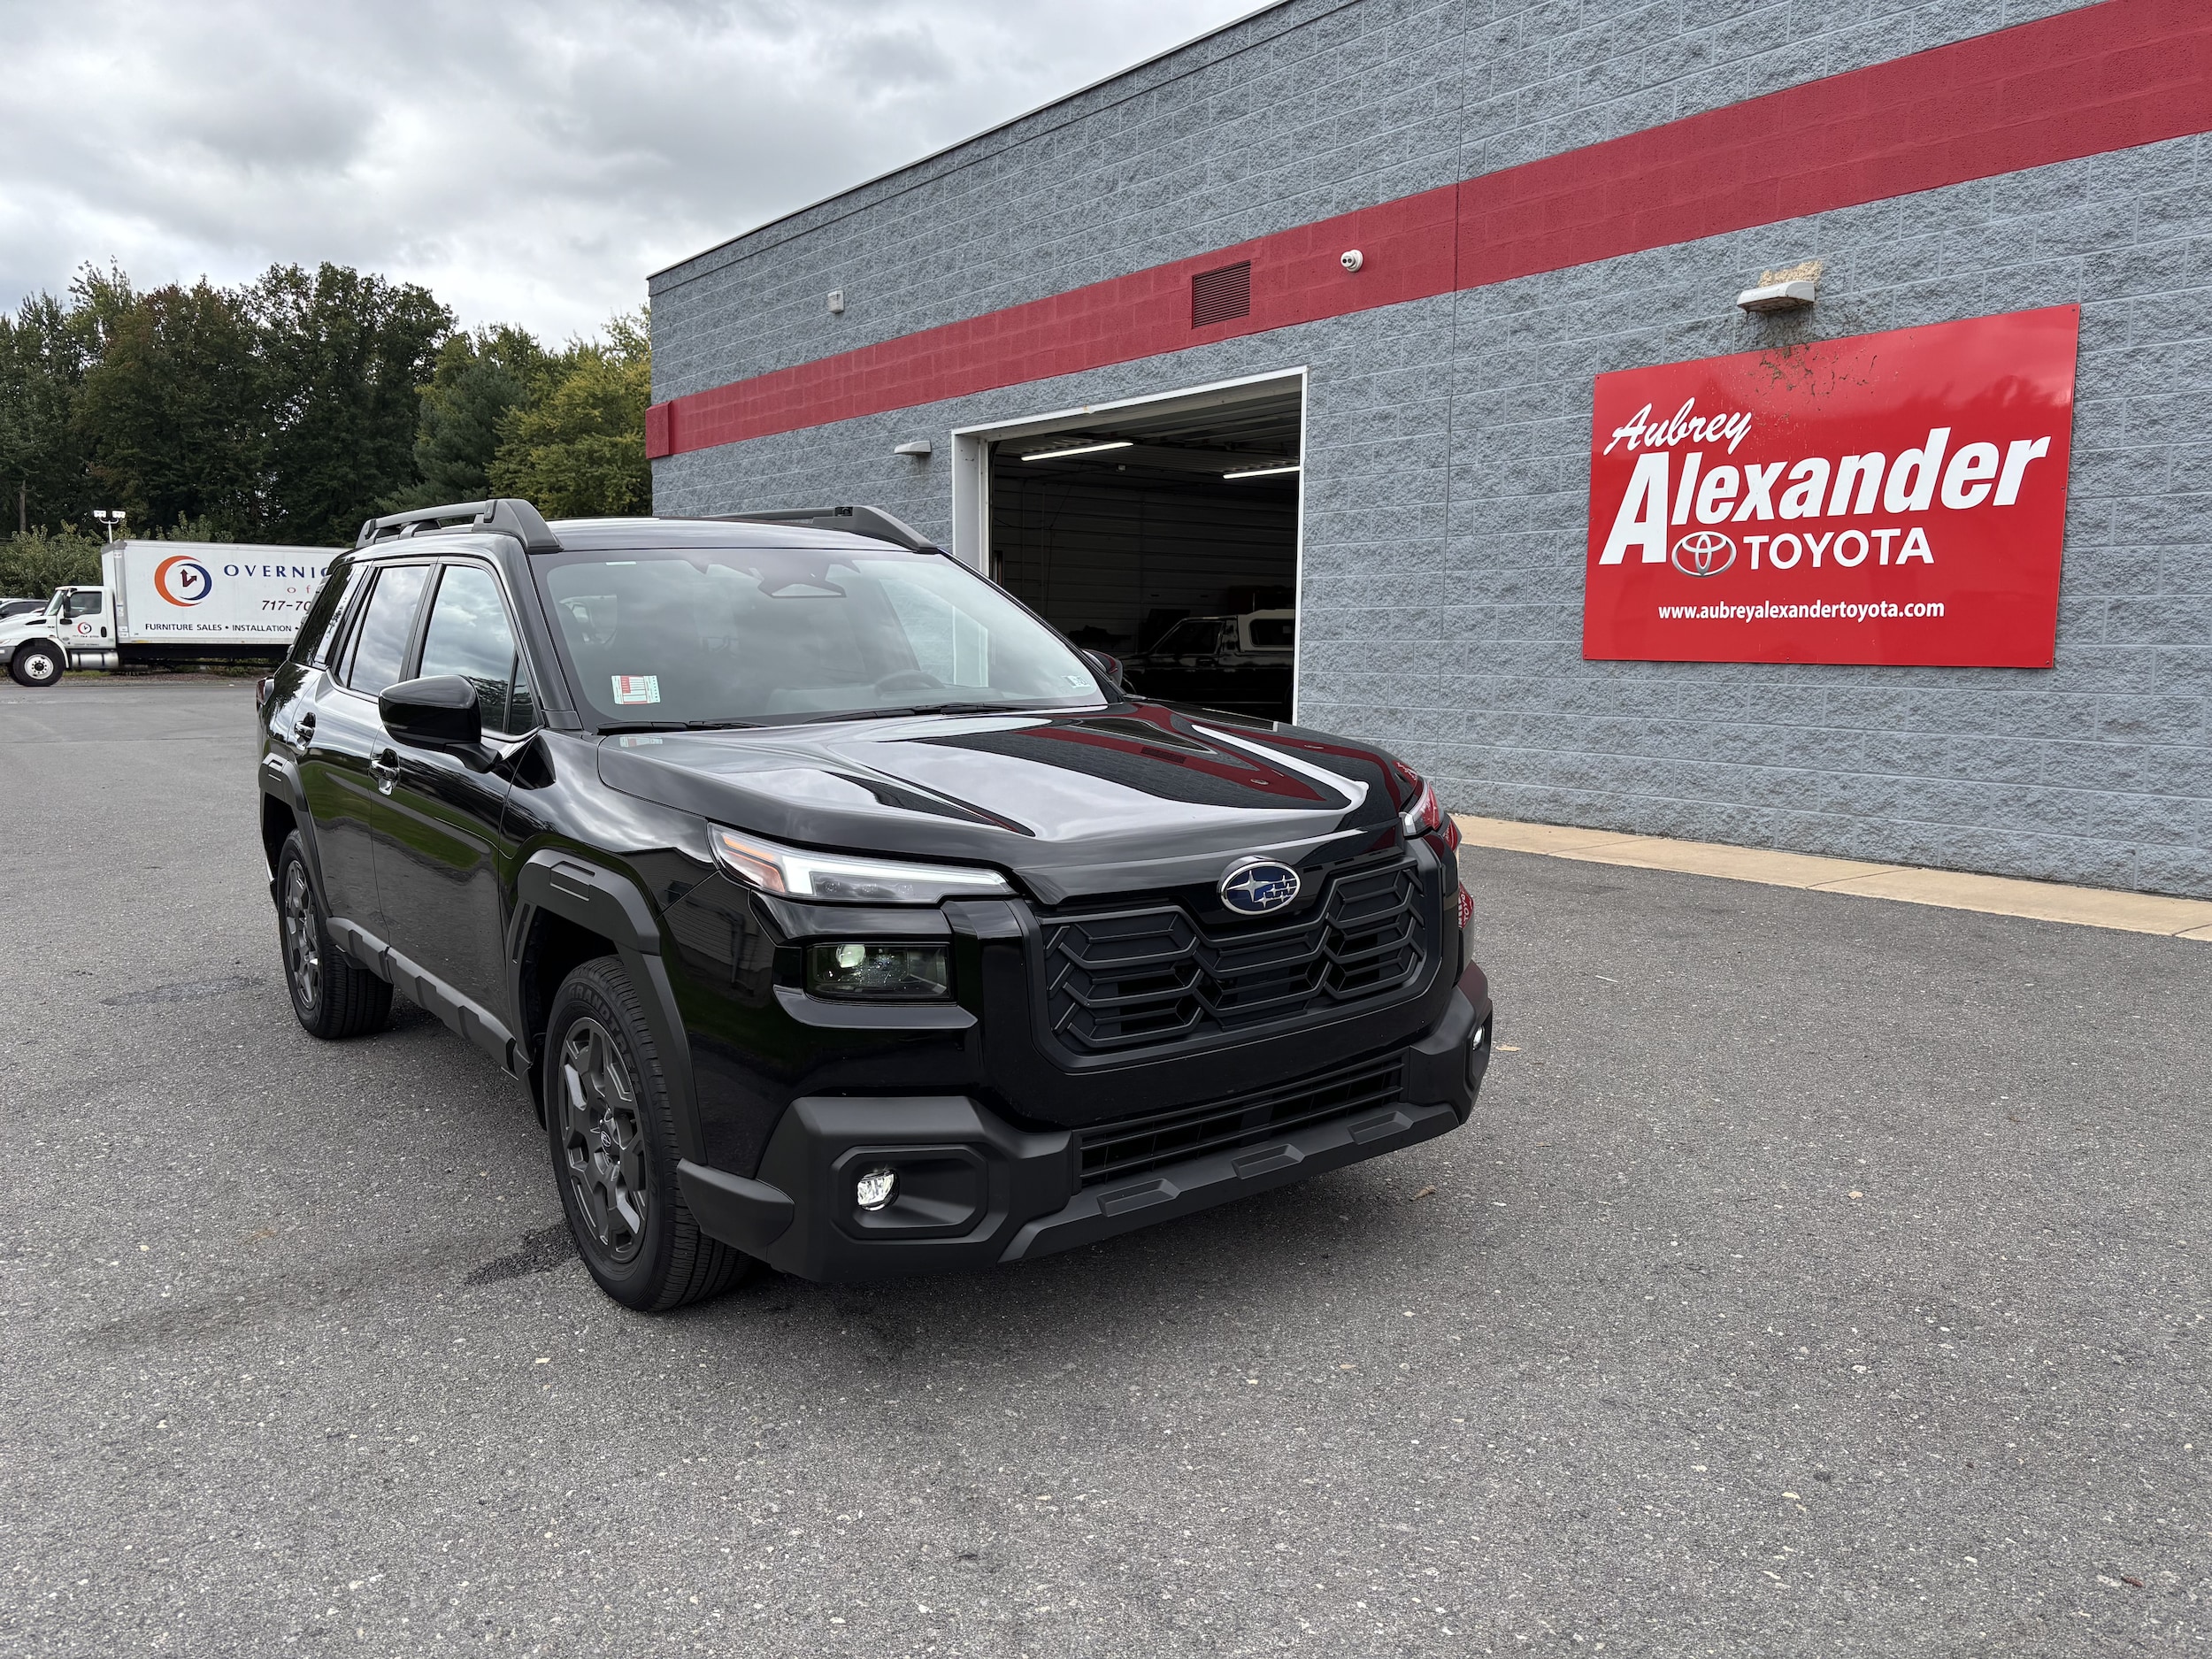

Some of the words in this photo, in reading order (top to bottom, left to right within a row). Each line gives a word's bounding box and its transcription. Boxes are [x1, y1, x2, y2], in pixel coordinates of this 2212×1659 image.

[1601, 396, 1752, 455] Aubrey
[1599, 426, 2051, 565] Alexander
[1743, 527, 1935, 571] TOYOTA
[145, 623, 193, 632] FURNITURE
[1658, 598, 1945, 623] www.aubreyalexandertoyota.com
